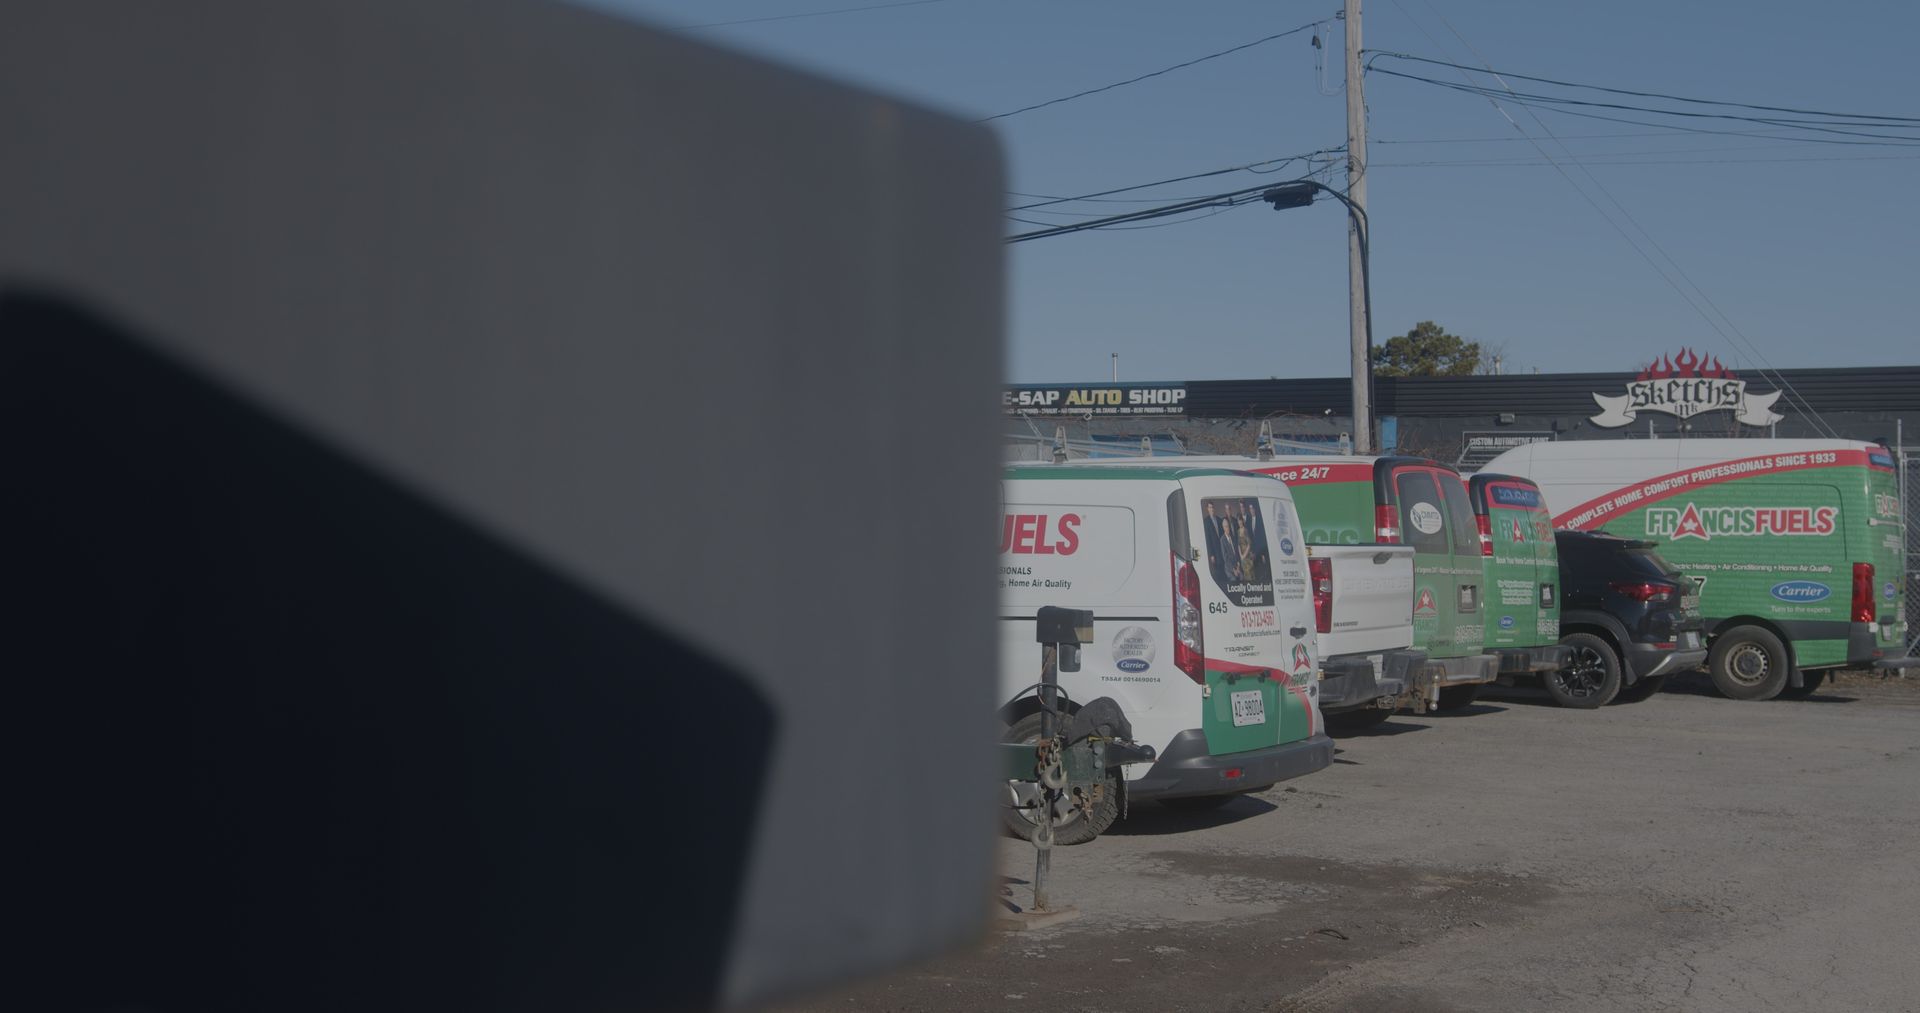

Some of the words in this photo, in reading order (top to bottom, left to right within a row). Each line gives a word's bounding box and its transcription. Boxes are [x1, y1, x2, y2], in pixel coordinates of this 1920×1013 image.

[1065, 389, 1122, 405] AUTO
[1129, 389, 1186, 404] SHOP
[1301, 467, 1330, 479] 24/7
[1567, 501, 1615, 530] COMPLETE
[1614, 489, 1644, 508] HOME
[1644, 474, 1690, 496] COMFORT
[1691, 458, 1774, 482] PROFESSIONALS
[1775, 454, 1807, 467] SINCE
[1808, 452, 1836, 464] 1933
[1692, 563, 1716, 571] Heating
[1732, 563, 1773, 572] Conditioning
[1808, 565, 1832, 573] Quality
[1008, 579, 1030, 587] Home
[1031, 579, 1043, 587] Air
[1044, 579, 1072, 590] Quality
[1227, 583, 1246, 594] Locally
[1246, 583, 1263, 592] Owned
[1263, 583, 1272, 592] and
[1778, 585, 1825, 597] Carrier
[1241, 595, 1263, 606] Operated
[1209, 602, 1228, 614] 645
[1771, 605, 1786, 613] Turn
[1806, 606, 1831, 615] experts
